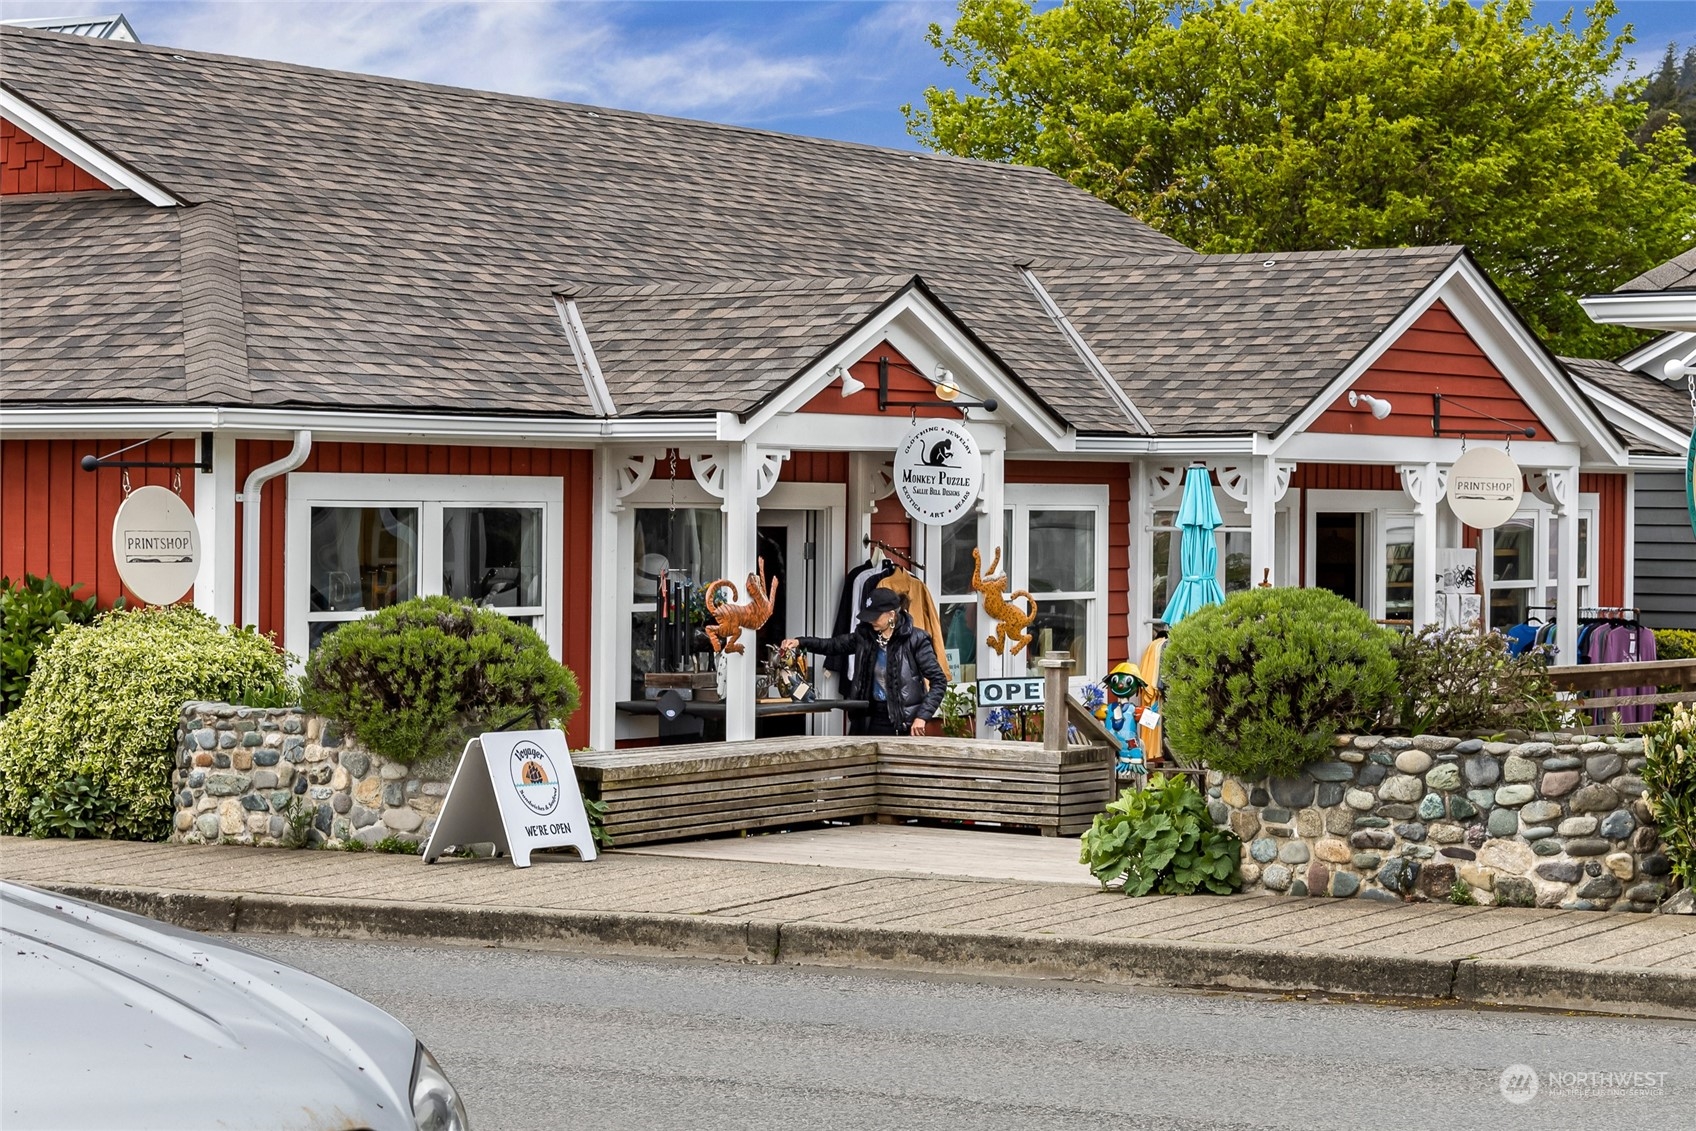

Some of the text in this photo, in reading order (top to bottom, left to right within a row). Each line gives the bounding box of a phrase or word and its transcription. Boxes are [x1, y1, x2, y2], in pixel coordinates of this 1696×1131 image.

[904, 426, 972, 455] CLOTHING JEWELRY
[902, 469, 970, 487] MONKEY PUZZLE
[1457, 481, 1512, 491] PRINTSHOP
[902, 486, 921, 512] EXOTICA
[954, 491, 971, 511] BEADS
[127, 537, 189, 550] PRINTSHOP
[984, 682, 1045, 701] OPE
[514, 747, 544, 761] Voyager
[525, 822, 572, 837] WE'RE OPEN
